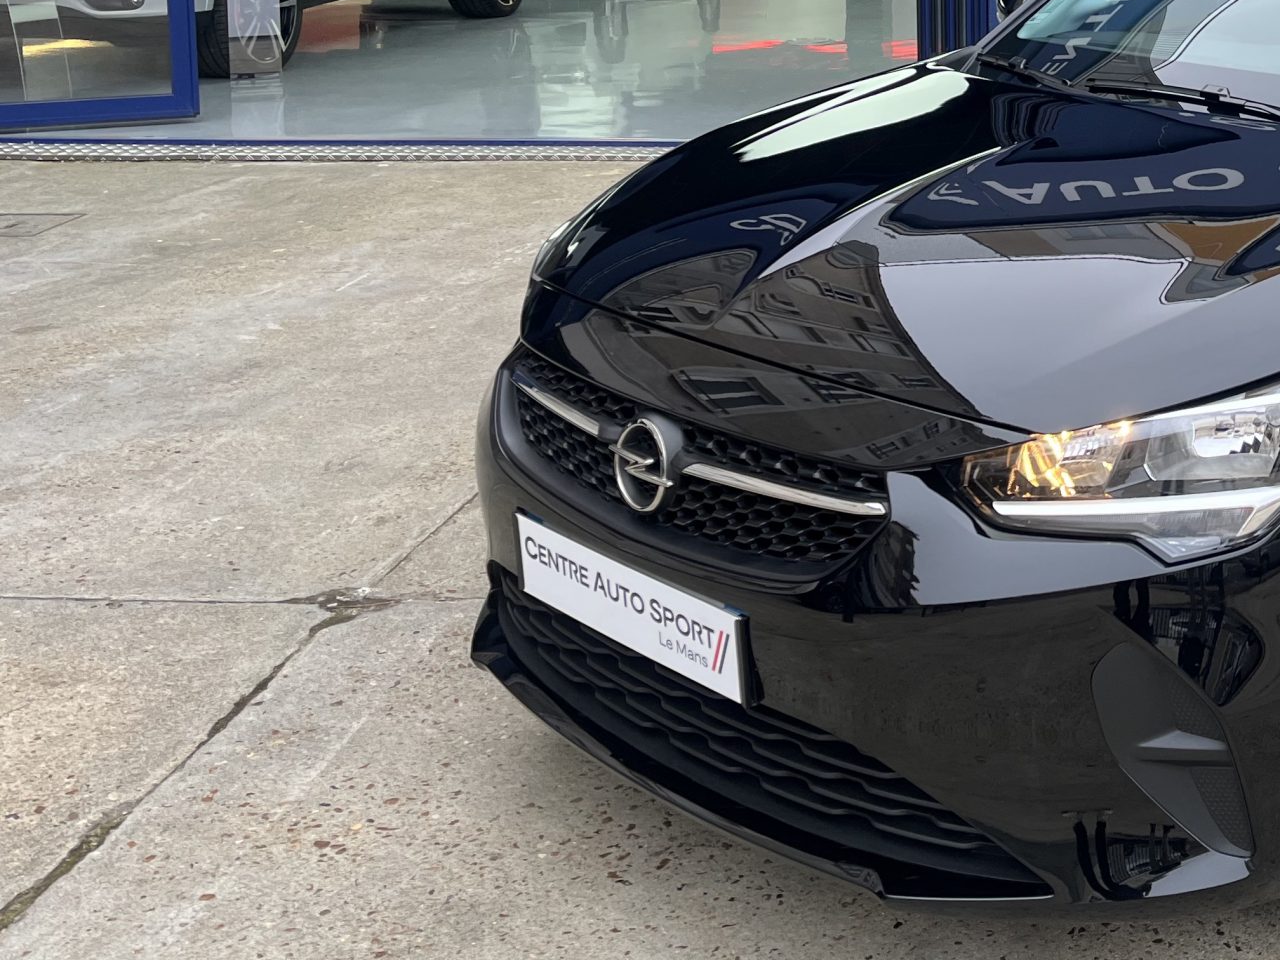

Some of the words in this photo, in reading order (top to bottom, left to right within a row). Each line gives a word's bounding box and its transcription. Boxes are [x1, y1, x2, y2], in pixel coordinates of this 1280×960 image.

[524, 535, 591, 589] CENTRE
[593, 571, 645, 615] AUTO
[649, 598, 715, 649] SPORT
[658, 631, 674, 650] Le
[676, 640, 709, 668] Mans
